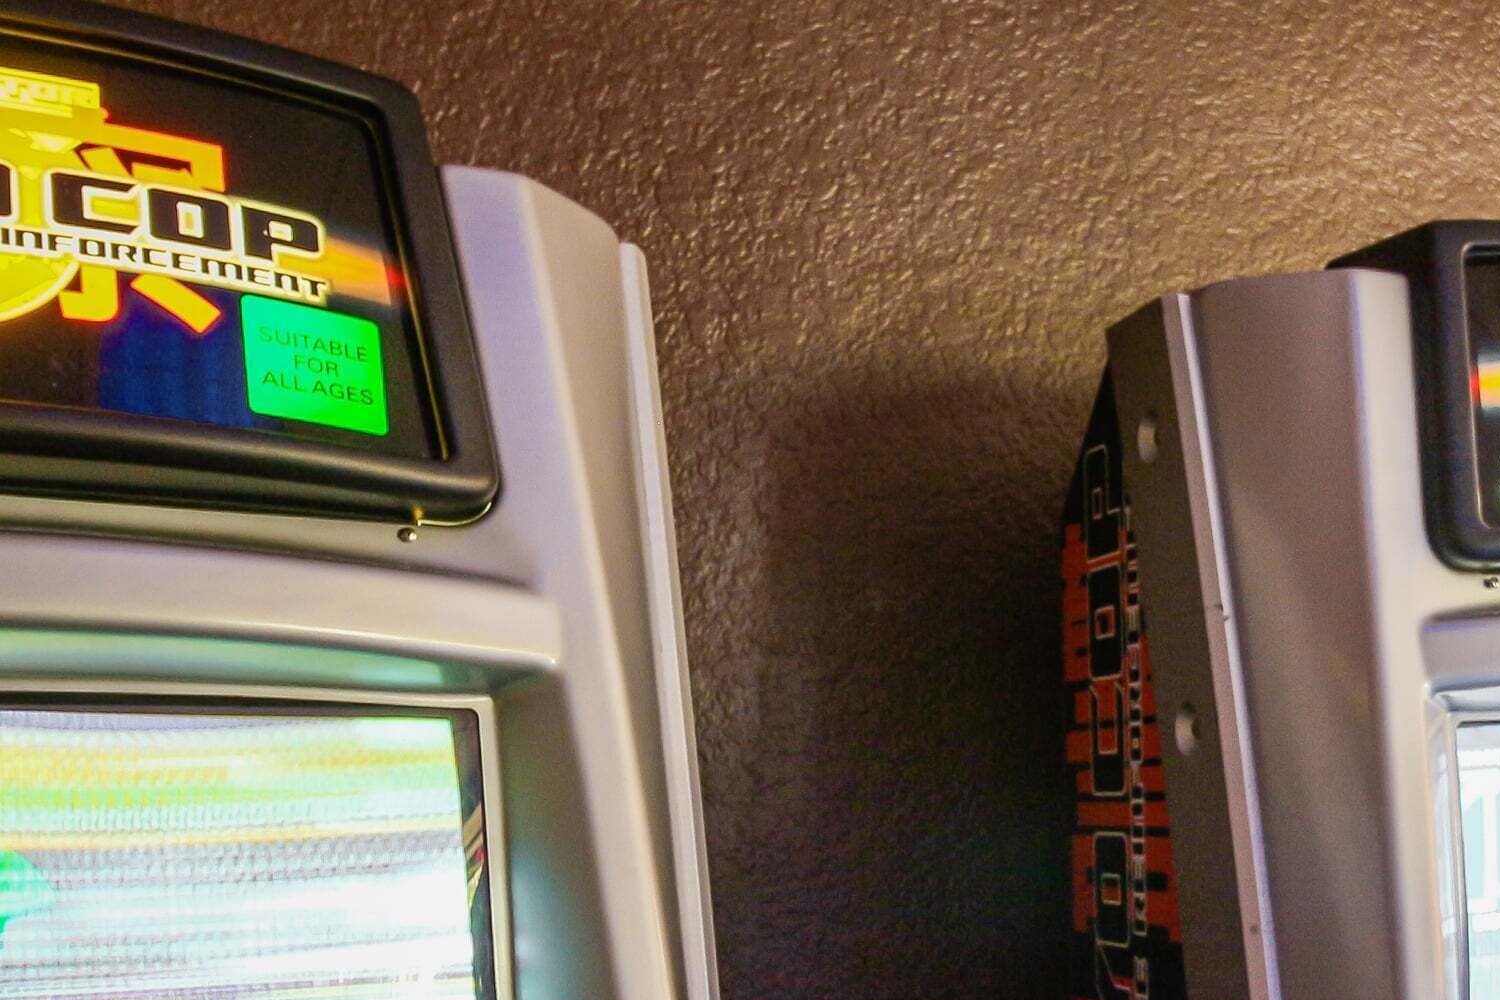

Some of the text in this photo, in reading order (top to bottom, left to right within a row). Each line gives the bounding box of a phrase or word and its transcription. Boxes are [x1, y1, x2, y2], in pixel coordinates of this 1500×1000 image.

[50, 171, 321, 261] COP
[257, 325, 370, 364] SUITABLE
[293, 353, 340, 378] FOR
[261, 370, 375, 407] ALL AGES
